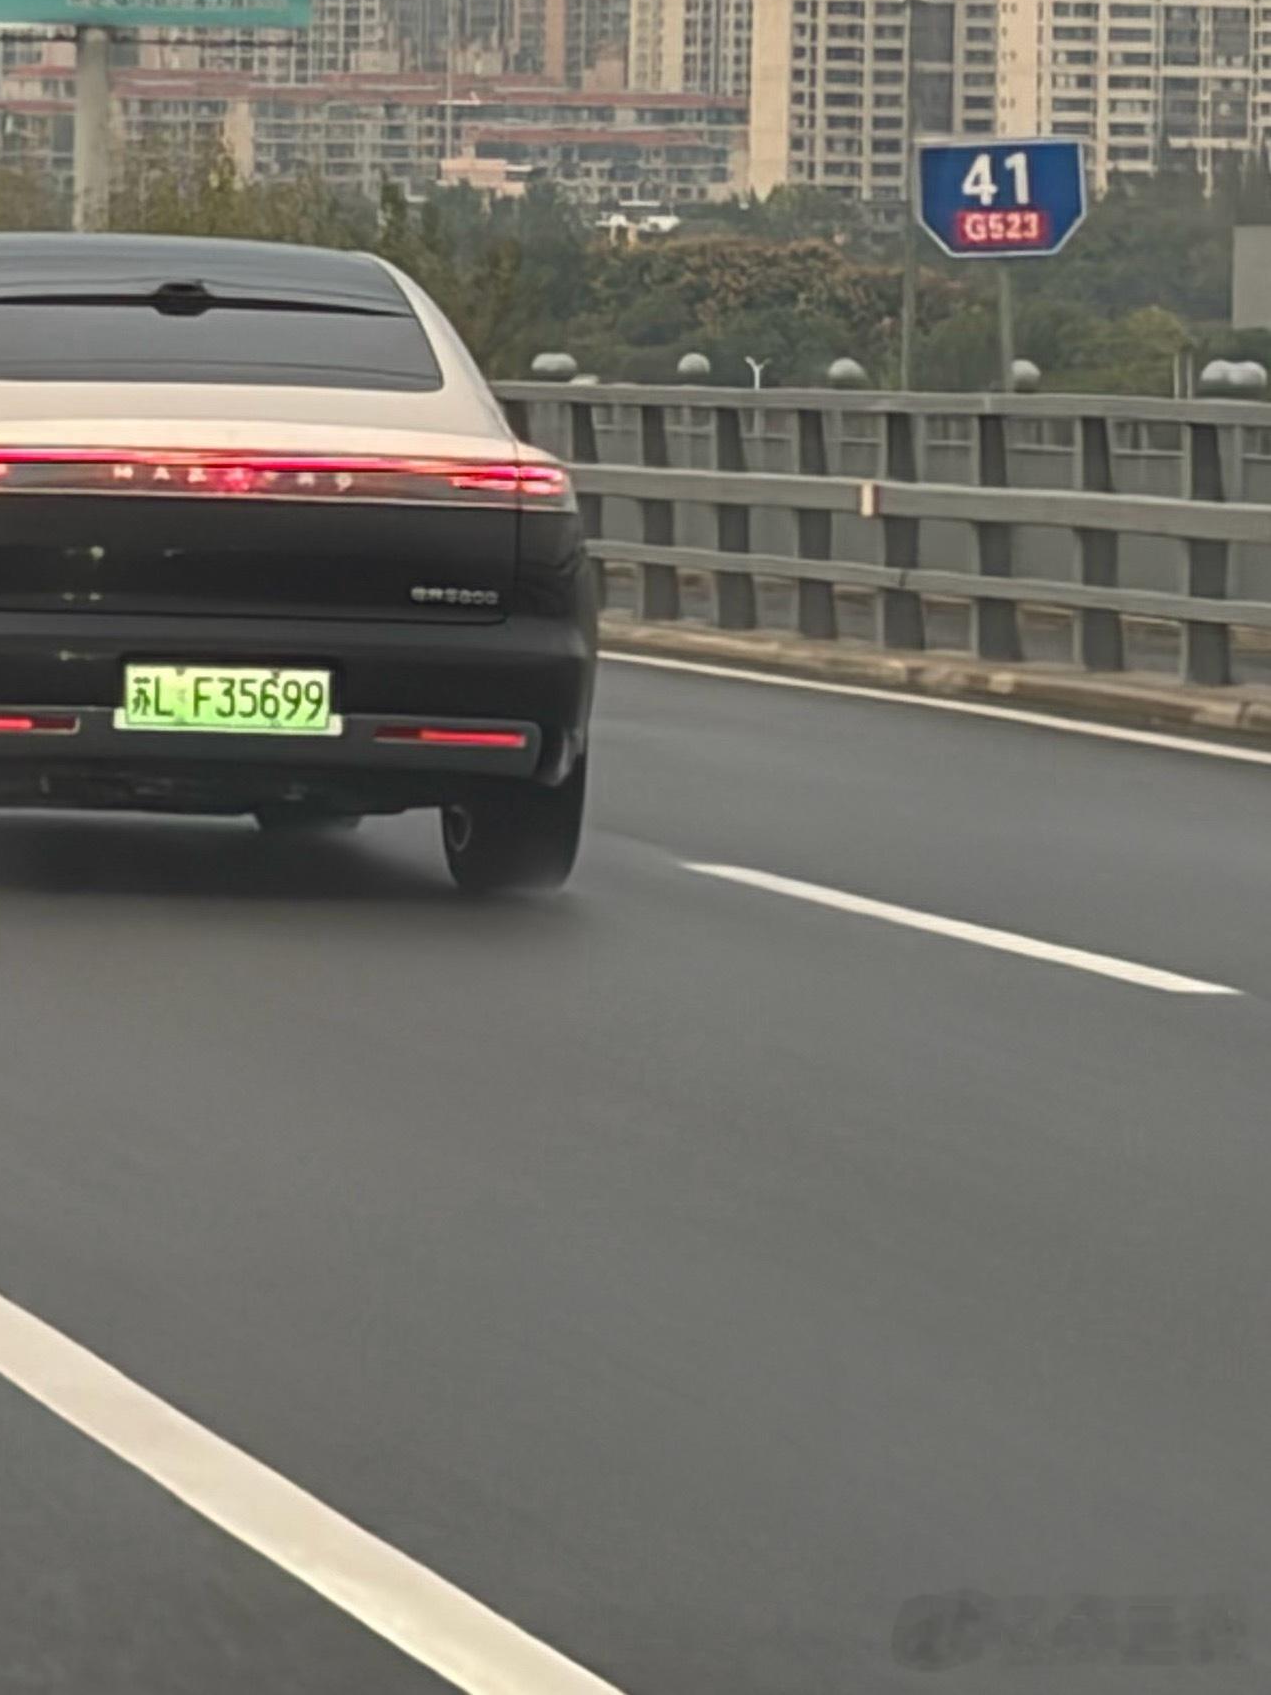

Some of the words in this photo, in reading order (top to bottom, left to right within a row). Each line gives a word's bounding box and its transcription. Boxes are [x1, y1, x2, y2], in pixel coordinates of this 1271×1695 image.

[961, 152, 1030, 206] 41
[964, 212, 1040, 241] G523
[192, 675, 325, 723] F35699
